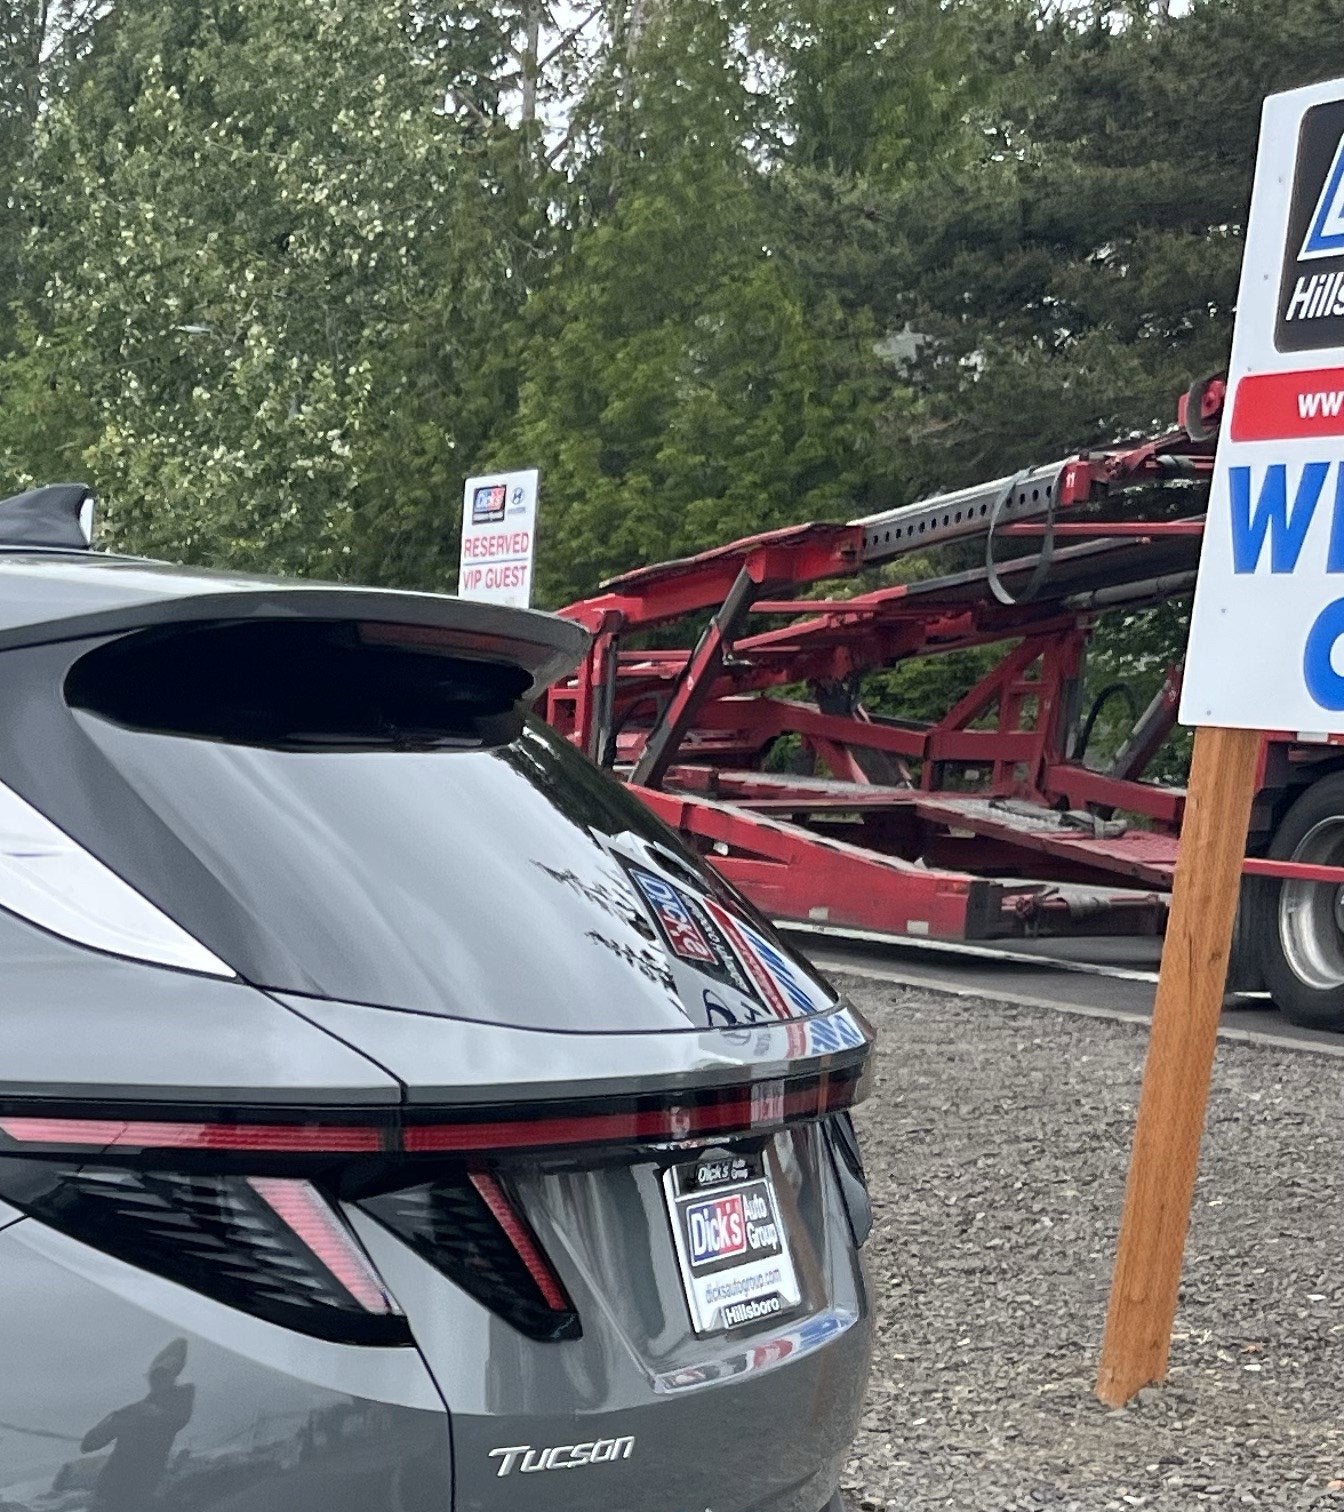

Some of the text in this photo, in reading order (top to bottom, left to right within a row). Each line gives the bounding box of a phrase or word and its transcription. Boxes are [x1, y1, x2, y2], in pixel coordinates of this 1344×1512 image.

[464, 533, 529, 558] RESERVED
[463, 565, 528, 589] VIP GUEST
[743, 1194, 768, 1222] Auto
[690, 1203, 743, 1256] Dick's
[746, 1223, 779, 1250] Group
[725, 1297, 780, 1325] Hillsboro
